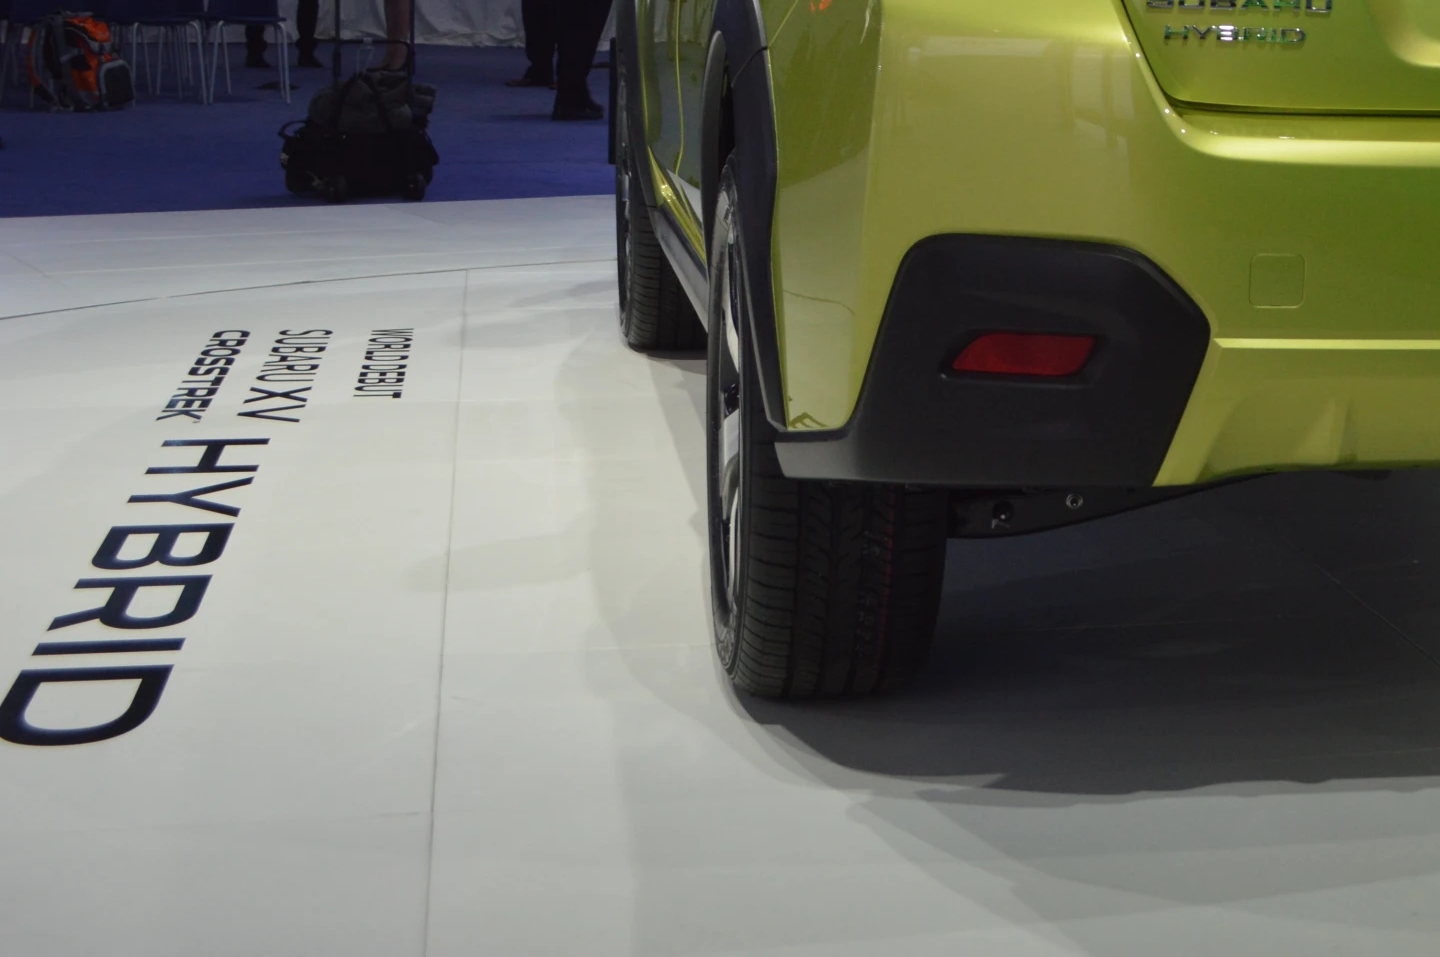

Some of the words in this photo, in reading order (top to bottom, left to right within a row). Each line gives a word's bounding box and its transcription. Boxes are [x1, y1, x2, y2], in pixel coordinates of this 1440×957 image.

[1164, 24, 1306, 43] HYBRID
[255, 329, 333, 382] SUBARU
[362, 328, 414, 362] WORLD
[155, 329, 251, 422] CROSSTREK
[353, 364, 407, 398] DEBUT
[237, 386, 312, 423] XV
[0, 437, 271, 746] HYBRID
